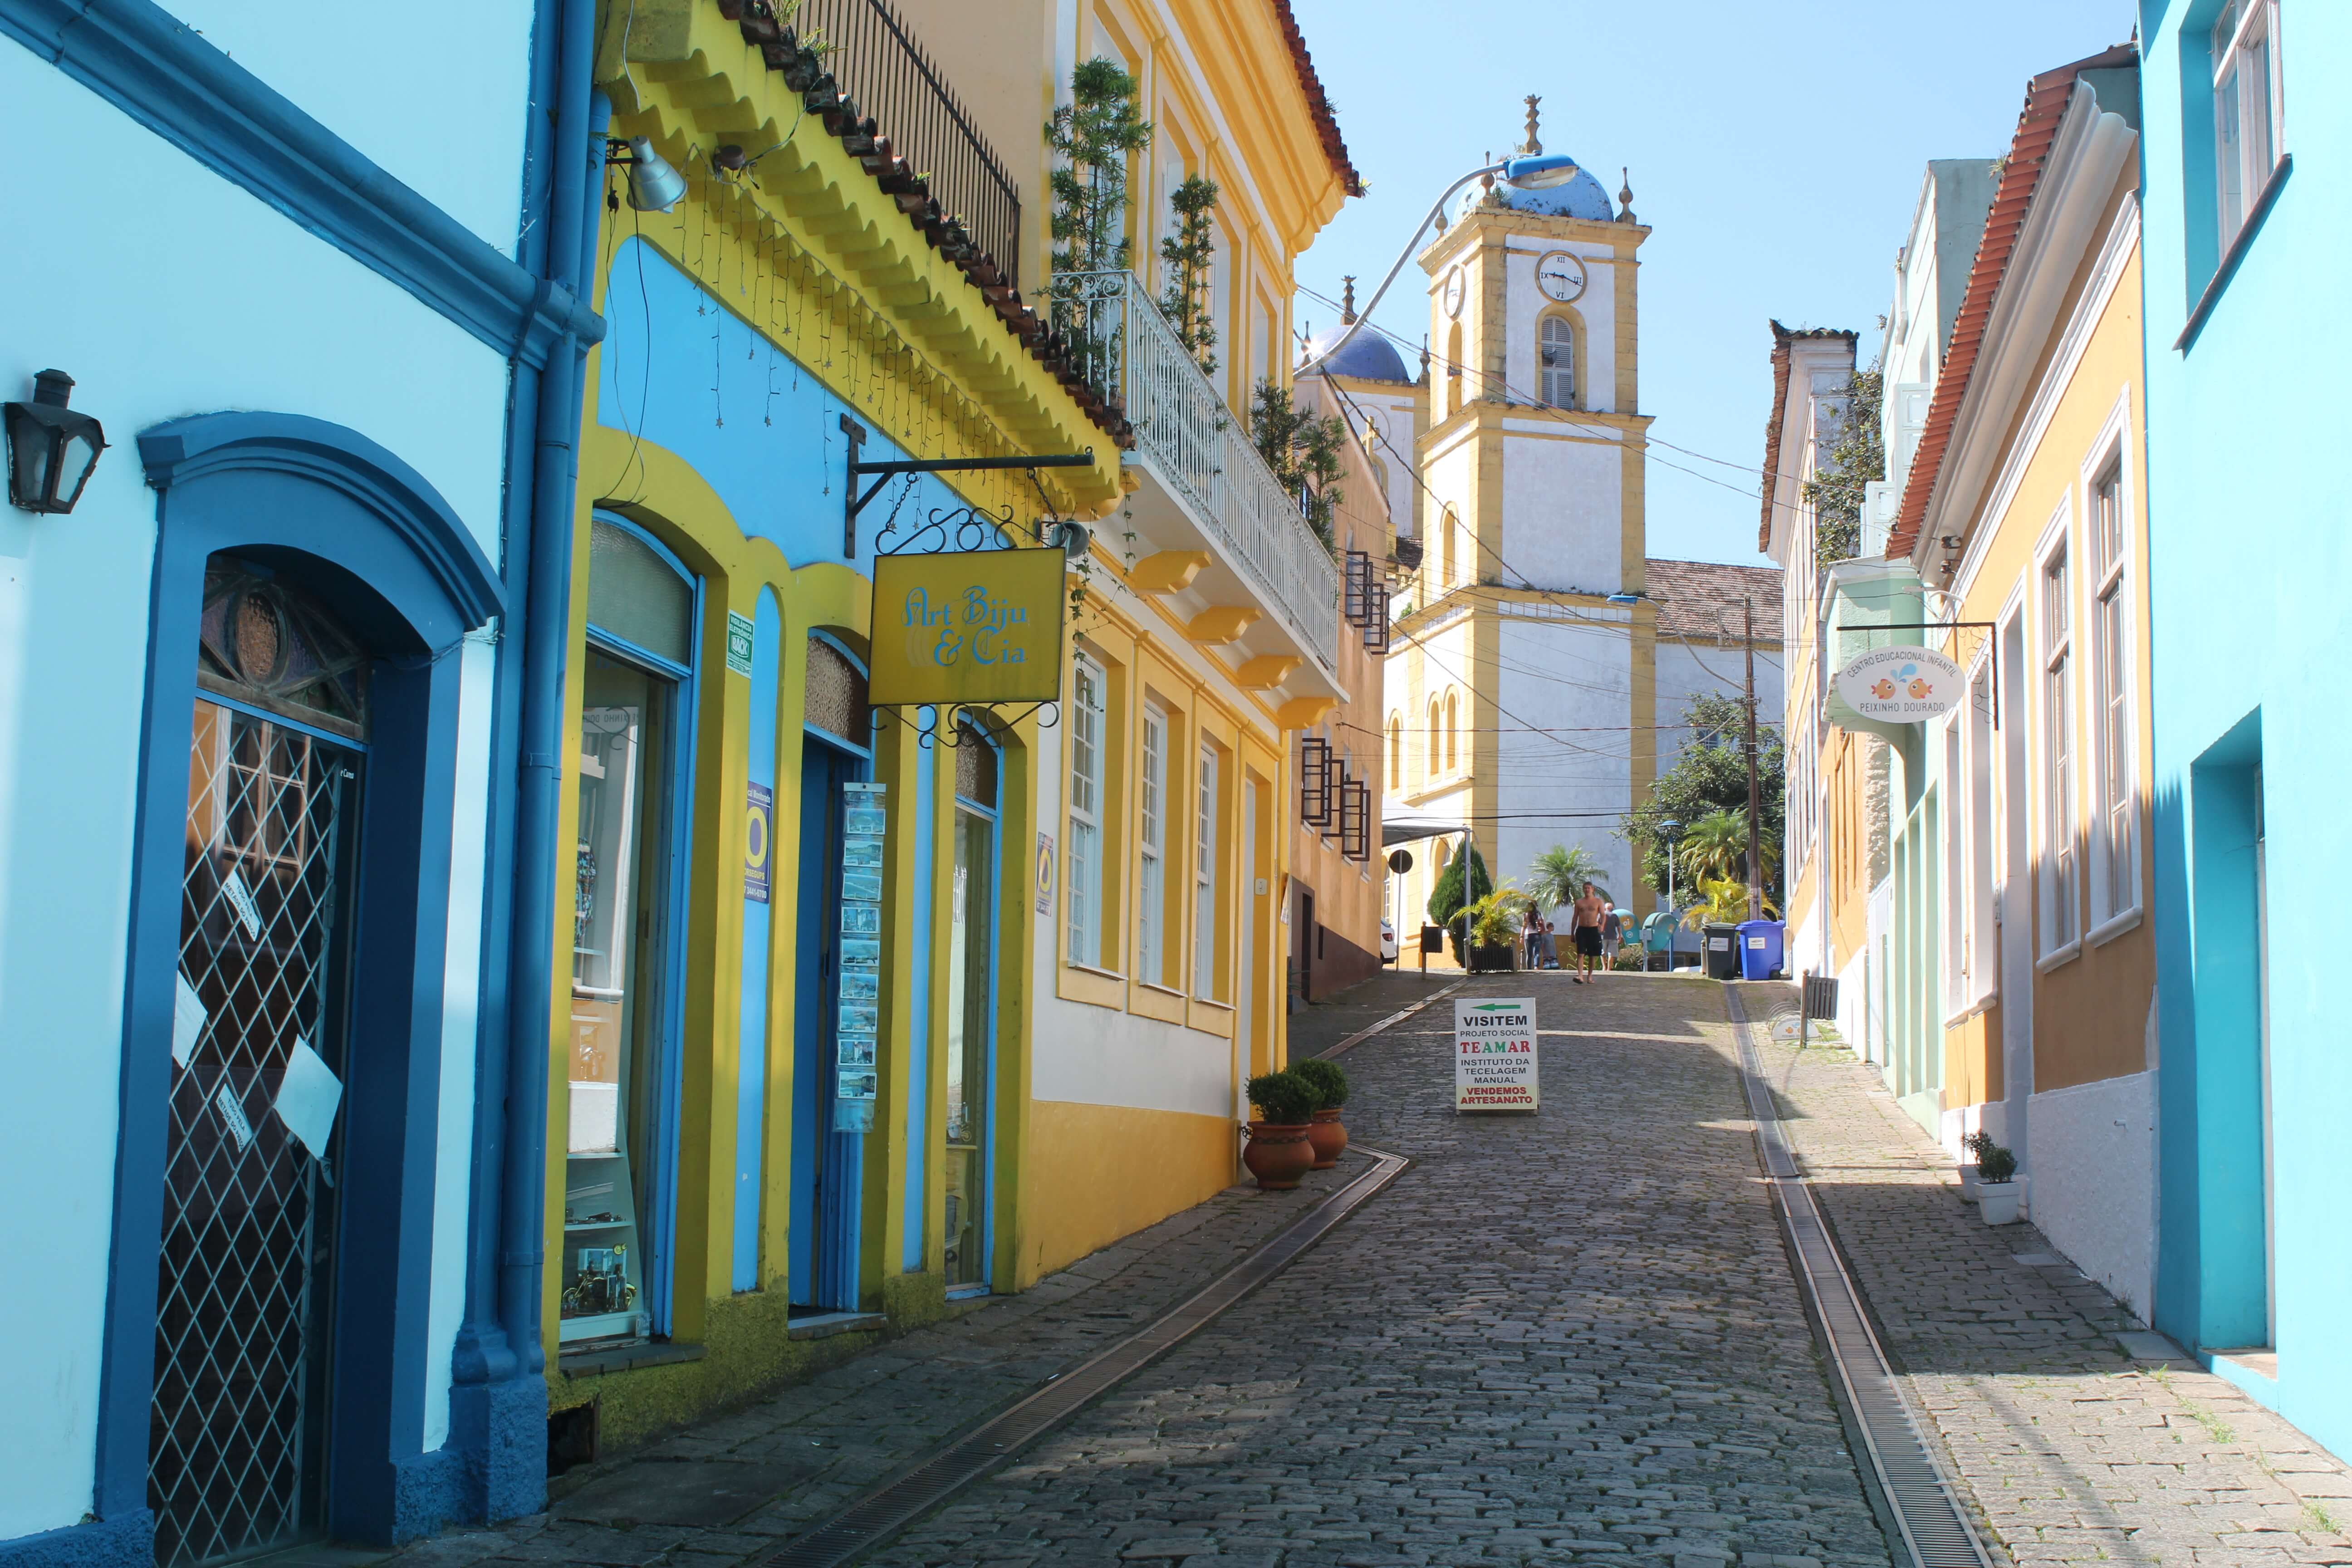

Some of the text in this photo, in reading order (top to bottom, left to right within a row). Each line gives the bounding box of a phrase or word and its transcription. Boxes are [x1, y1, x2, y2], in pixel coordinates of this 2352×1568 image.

[901, 585, 1027, 634] Art Biju
[732, 637, 748, 655] BACK
[934, 626, 1028, 666] & Cia
[1847, 651, 1956, 678] CENTRO EDUCACIONAL INFANTIL
[1860, 702, 1945, 712] PEIXINHO DOURADO
[753, 790, 770, 804] Monitorado
[224, 882, 241, 907] METADE
[240, 907, 246, 916] DO
[237, 884, 245, 902] TUDO
[1463, 1015, 1527, 1026] VISITEM
[1460, 1041, 1530, 1054] TEAMAR
[1460, 1096, 1533, 1104] ARTESANATO
[1466, 1087, 1526, 1095] VENDEMOS
[219, 1097, 231, 1123] METADE
[230, 1121, 236, 1131] DO
[228, 1098, 245, 1132] TUDO PELA
